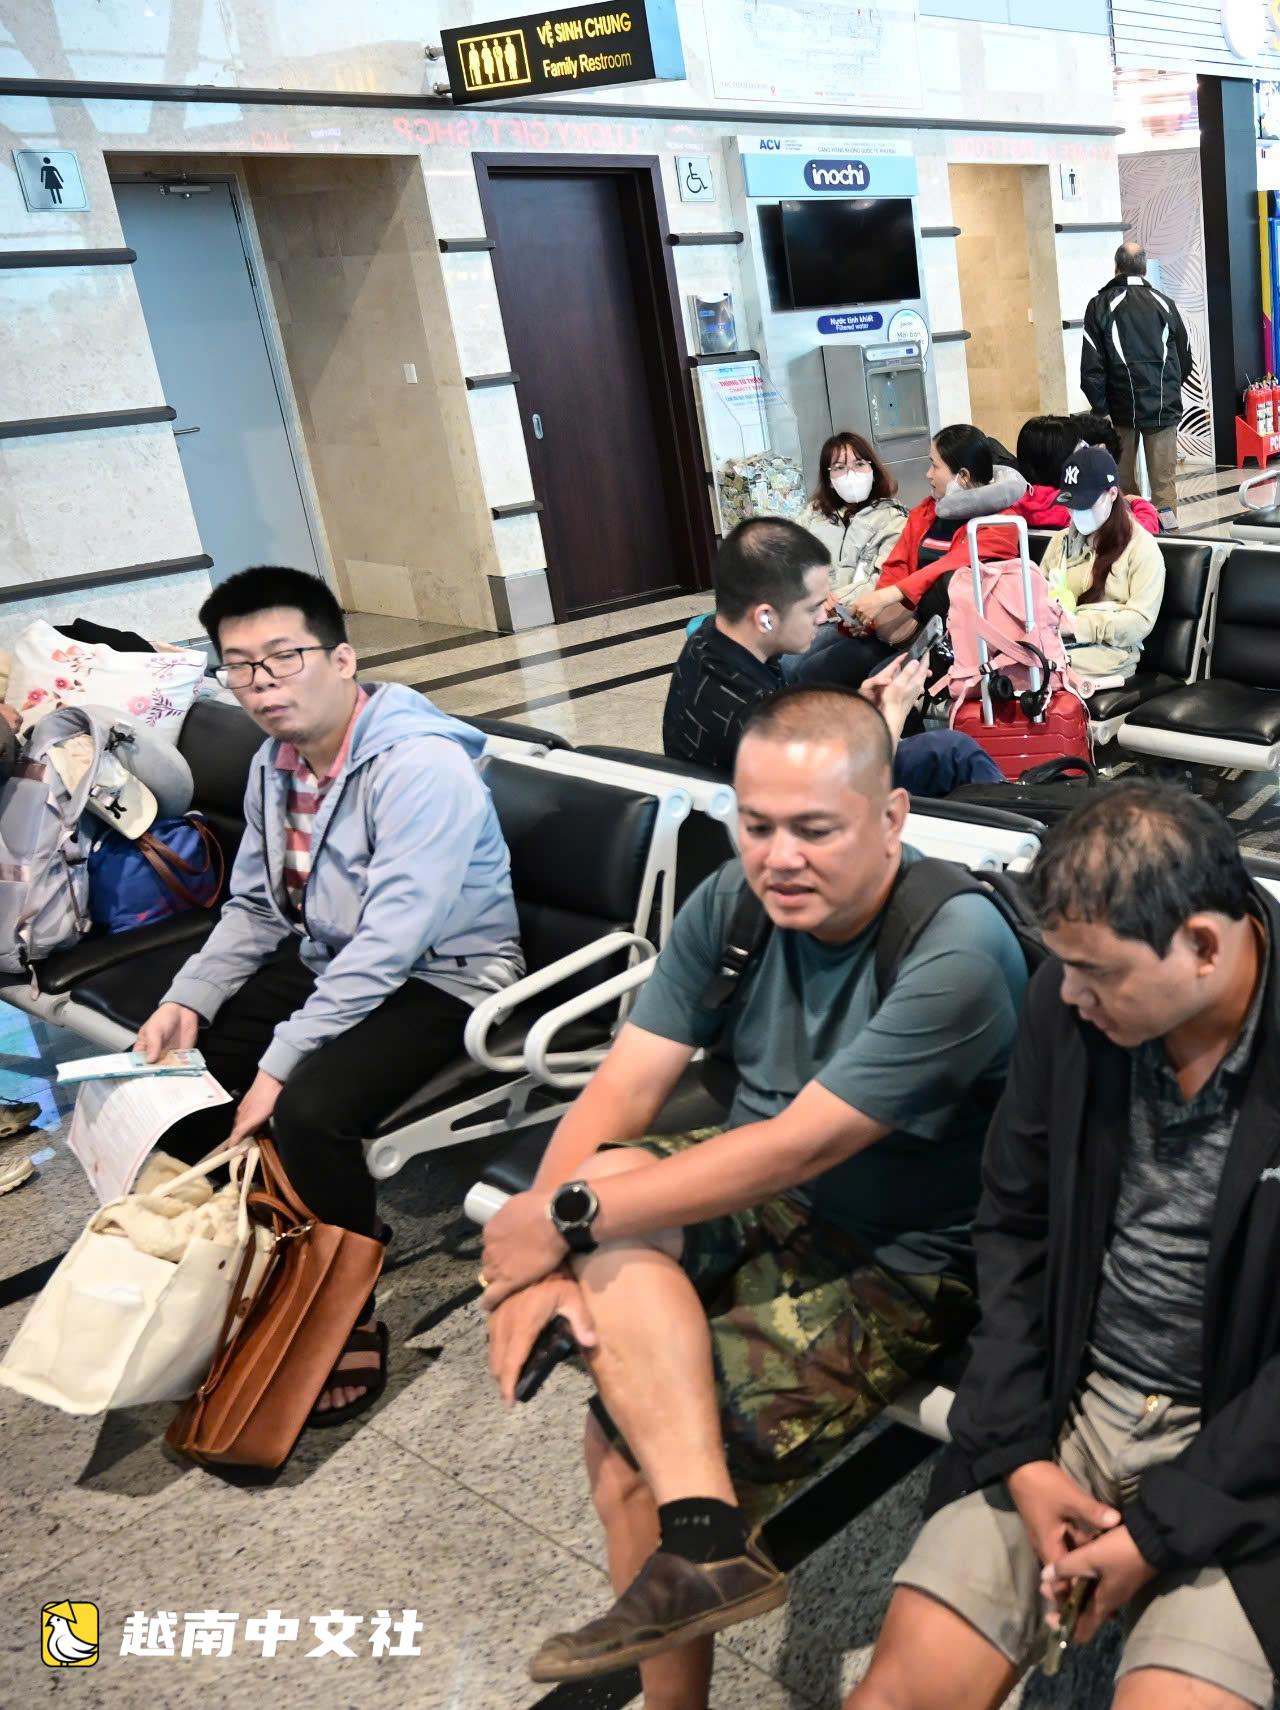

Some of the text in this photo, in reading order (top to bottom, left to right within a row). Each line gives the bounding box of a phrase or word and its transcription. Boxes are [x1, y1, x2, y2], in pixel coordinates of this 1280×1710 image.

[536, 12, 632, 48] VỆ SINH CHUNG
[542, 52, 632, 79] Family Restroom
[759, 139, 781, 151] ACV
[811, 163, 865, 185] inochi
[1064, 465, 1080, 485] NY
